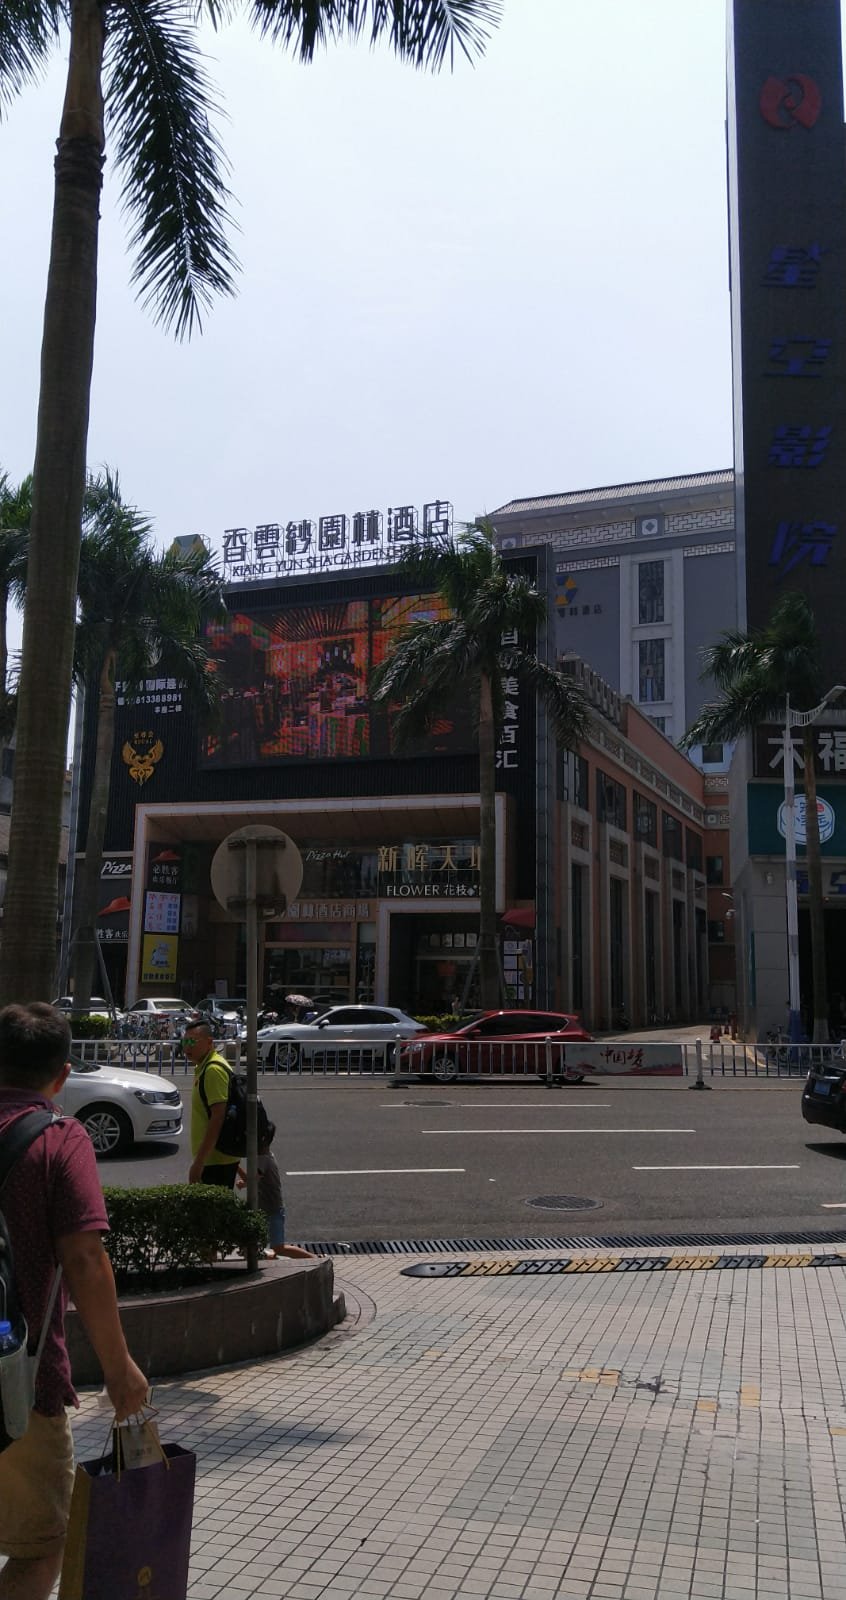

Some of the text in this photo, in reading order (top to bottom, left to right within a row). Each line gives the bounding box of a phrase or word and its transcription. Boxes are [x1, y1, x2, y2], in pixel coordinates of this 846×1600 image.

[222, 500, 452, 563] 香雲紗園林酒店
[276, 557, 303, 572] YUN
[307, 553, 332, 569] SHA
[305, 850, 333, 861] Pizza
[101, 861, 132, 874] Pizza
[386, 884, 439, 897] FLOWER
[600, 1046, 644, 1067] 中国梦
